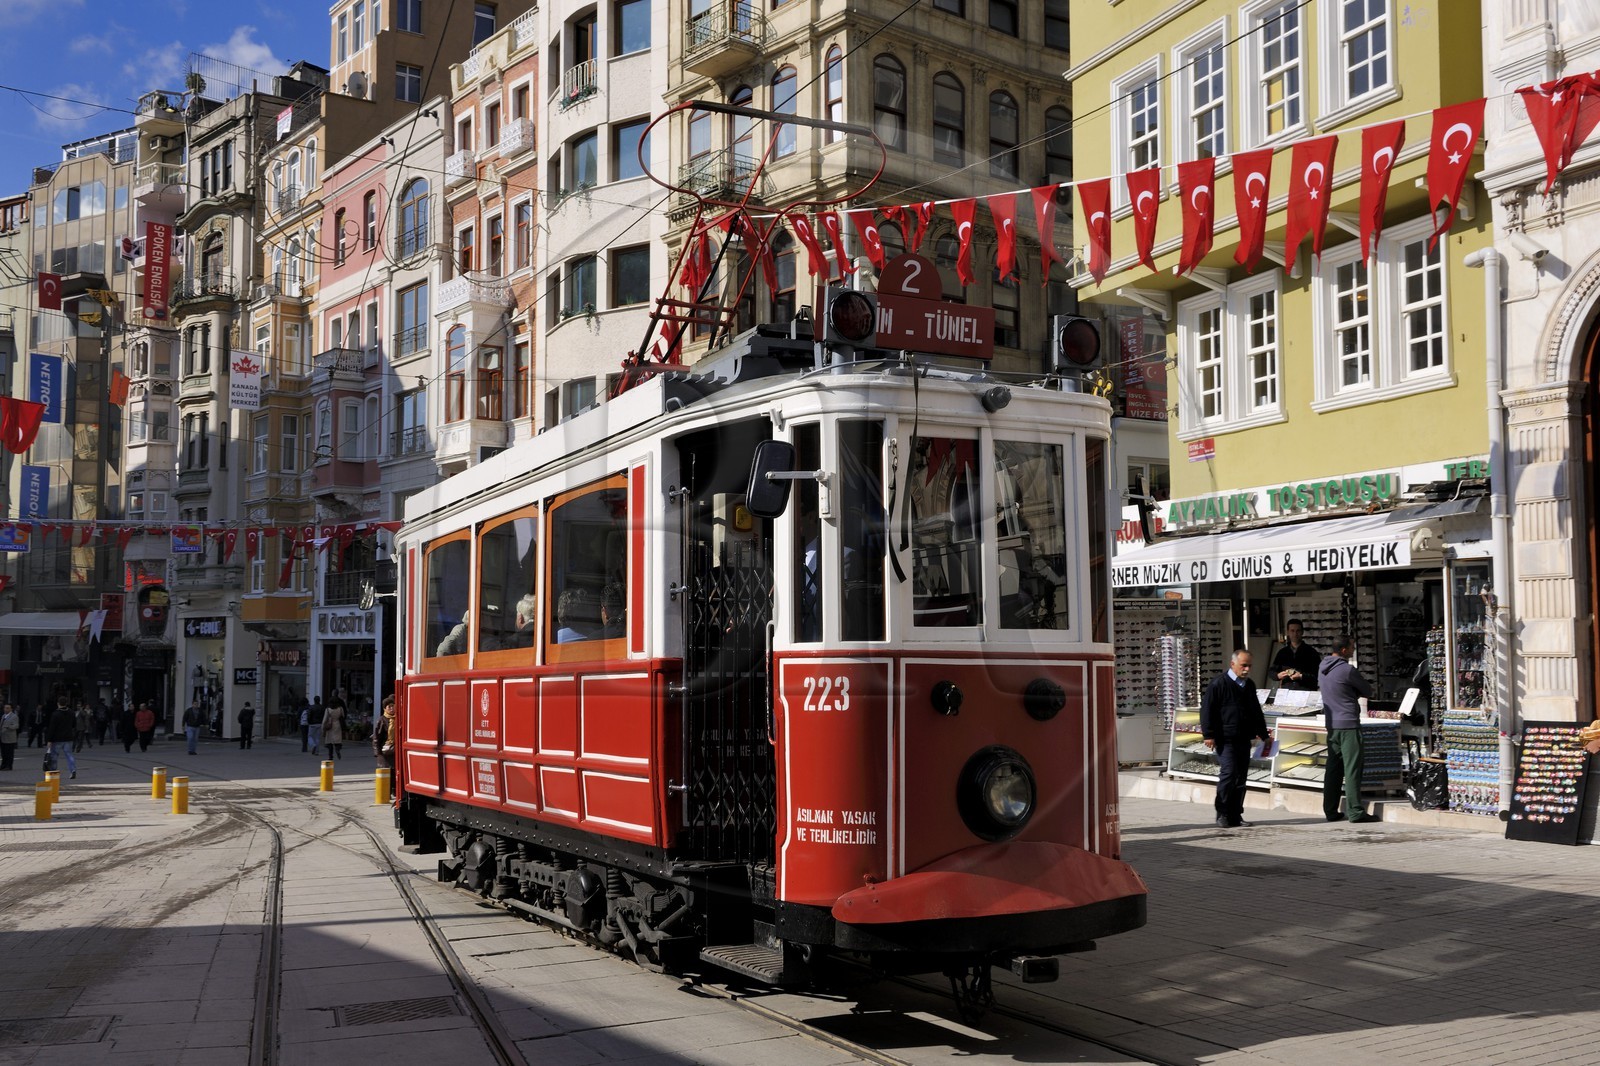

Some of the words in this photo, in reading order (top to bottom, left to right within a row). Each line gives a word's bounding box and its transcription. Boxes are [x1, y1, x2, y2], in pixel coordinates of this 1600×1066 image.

[152, 225, 165, 263] SPOKEN
[150, 265, 164, 307] ENGLISH
[901, 259, 922, 294] 2
[924, 309, 983, 344] TÜNEL
[231, 383, 258, 391] KANADA
[231, 391, 258, 399] KÜLTÜR
[231, 399, 258, 407] MERKEZİ
[1130, 408, 1150, 418] VİZE
[1168, 492, 1250, 524] AYVALIK
[1267, 474, 1391, 511] TOSTCUSU
[1143, 562, 1181, 584] MÜZİK
[1191, 560, 1208, 581] CD
[1283, 552, 1293, 574] &
[1308, 541, 1399, 572] HEDİYELİK
[803, 676, 850, 711] 223
[796, 807, 834, 824] ASILMAK
[841, 810, 876, 825] YASAK
[796, 827, 806, 841] VE
[810, 827, 877, 845] TEHLİKELİDİR
